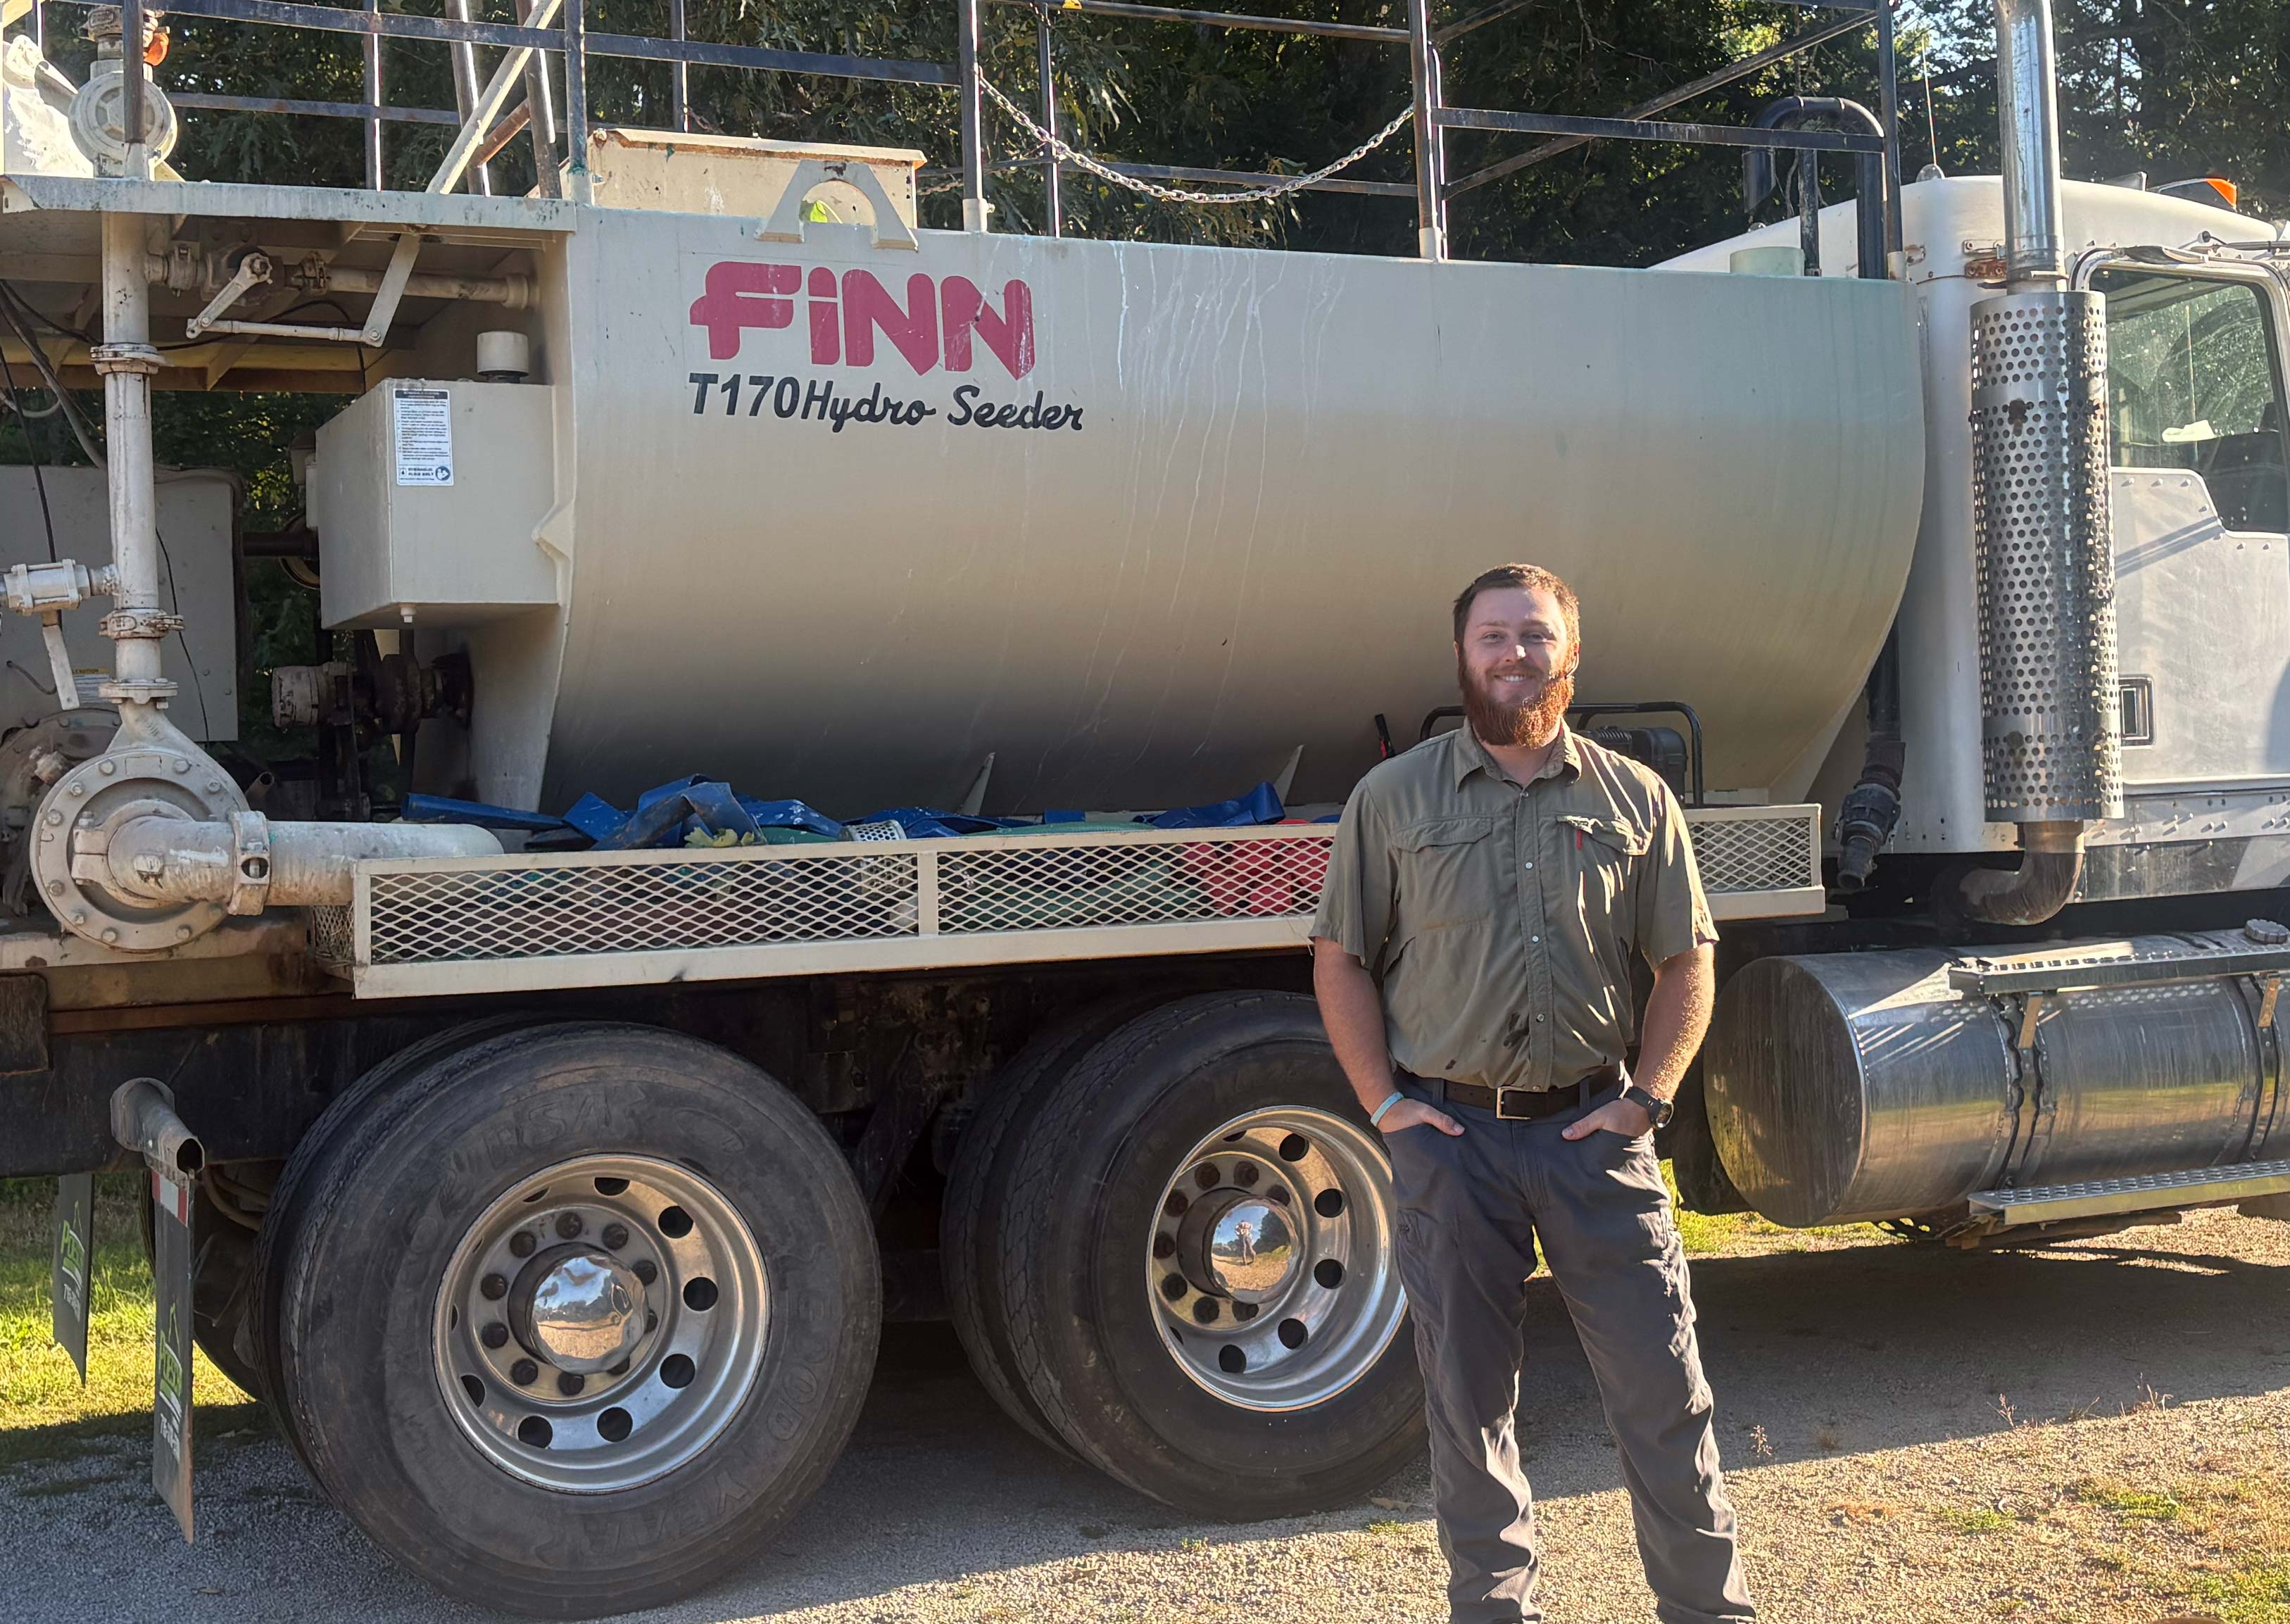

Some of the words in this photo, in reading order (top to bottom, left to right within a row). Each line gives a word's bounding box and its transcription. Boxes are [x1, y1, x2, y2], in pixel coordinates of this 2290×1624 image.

[689, 372, 800, 419] T170
[800, 379, 936, 433] Hydro
[947, 384, 1083, 431] Seeder
